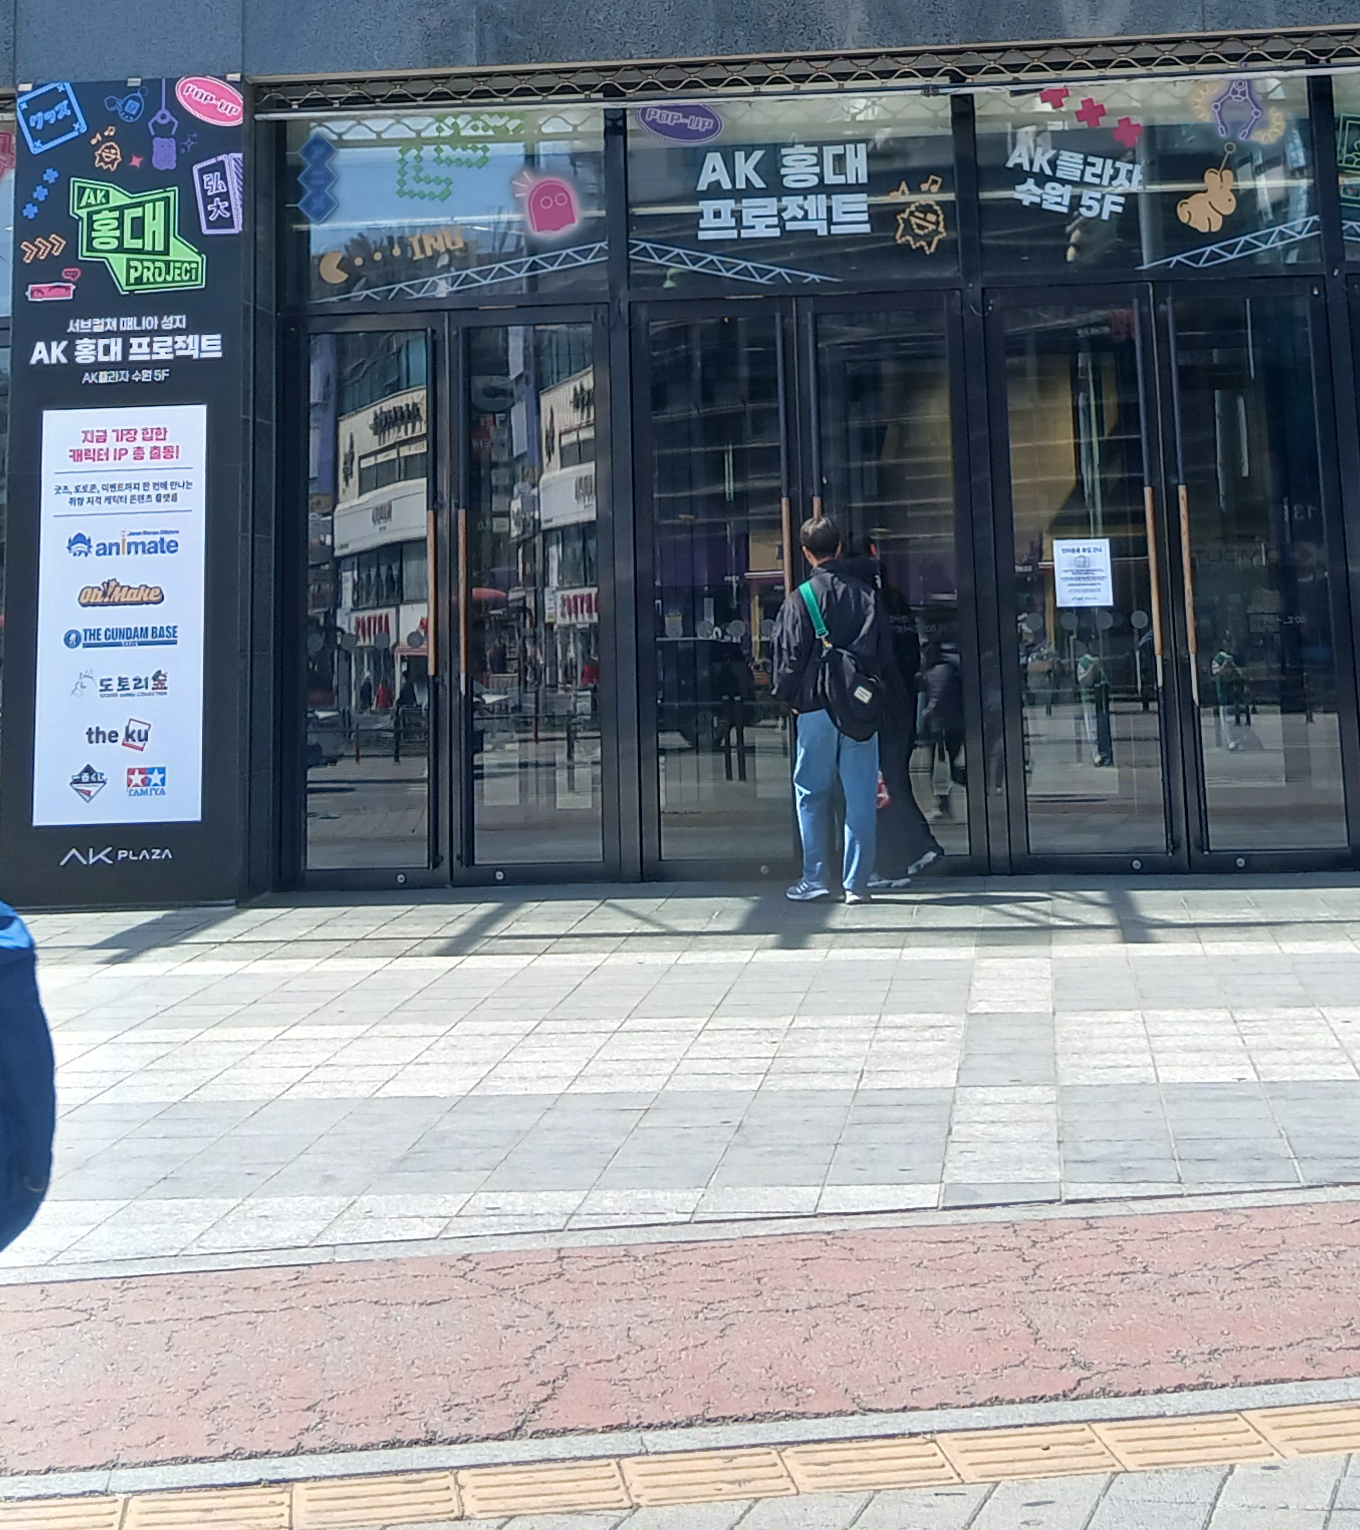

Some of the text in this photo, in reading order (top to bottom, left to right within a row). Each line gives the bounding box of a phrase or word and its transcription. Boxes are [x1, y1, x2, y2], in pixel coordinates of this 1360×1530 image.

[183, 84, 240, 116] POP-UP
[646, 107, 714, 132] POP-UP
[696, 143, 868, 191] AK 홍대
[1005, 144, 1143, 192] AK플라자
[80, 187, 108, 207] AK
[203, 171, 231, 221] 弘大
[1013, 177, 1126, 221] 수원 5F
[92, 201, 165, 251] 홍대
[697, 193, 871, 240] 프로젝트
[129, 259, 199, 283] PROJECT
[120, 316, 158, 331] 매니아
[161, 315, 186, 330] 성지
[30, 334, 222, 365] AK 홍대 프로젝트
[132, 370, 151, 382] 수원
[154, 369, 169, 381] 5F
[81, 429, 108, 443] 지금
[112, 428, 138, 442] 가장
[69, 448, 109, 462] 캐릭터
[113, 448, 128, 461] IP
[95, 530, 178, 557] animate
[83, 625, 178, 641] THE GUNDAM BASE
[86, 726, 149, 744] the ku
[128, 788, 166, 797] TAMIYA
[60, 847, 172, 865] AK PLAZA
